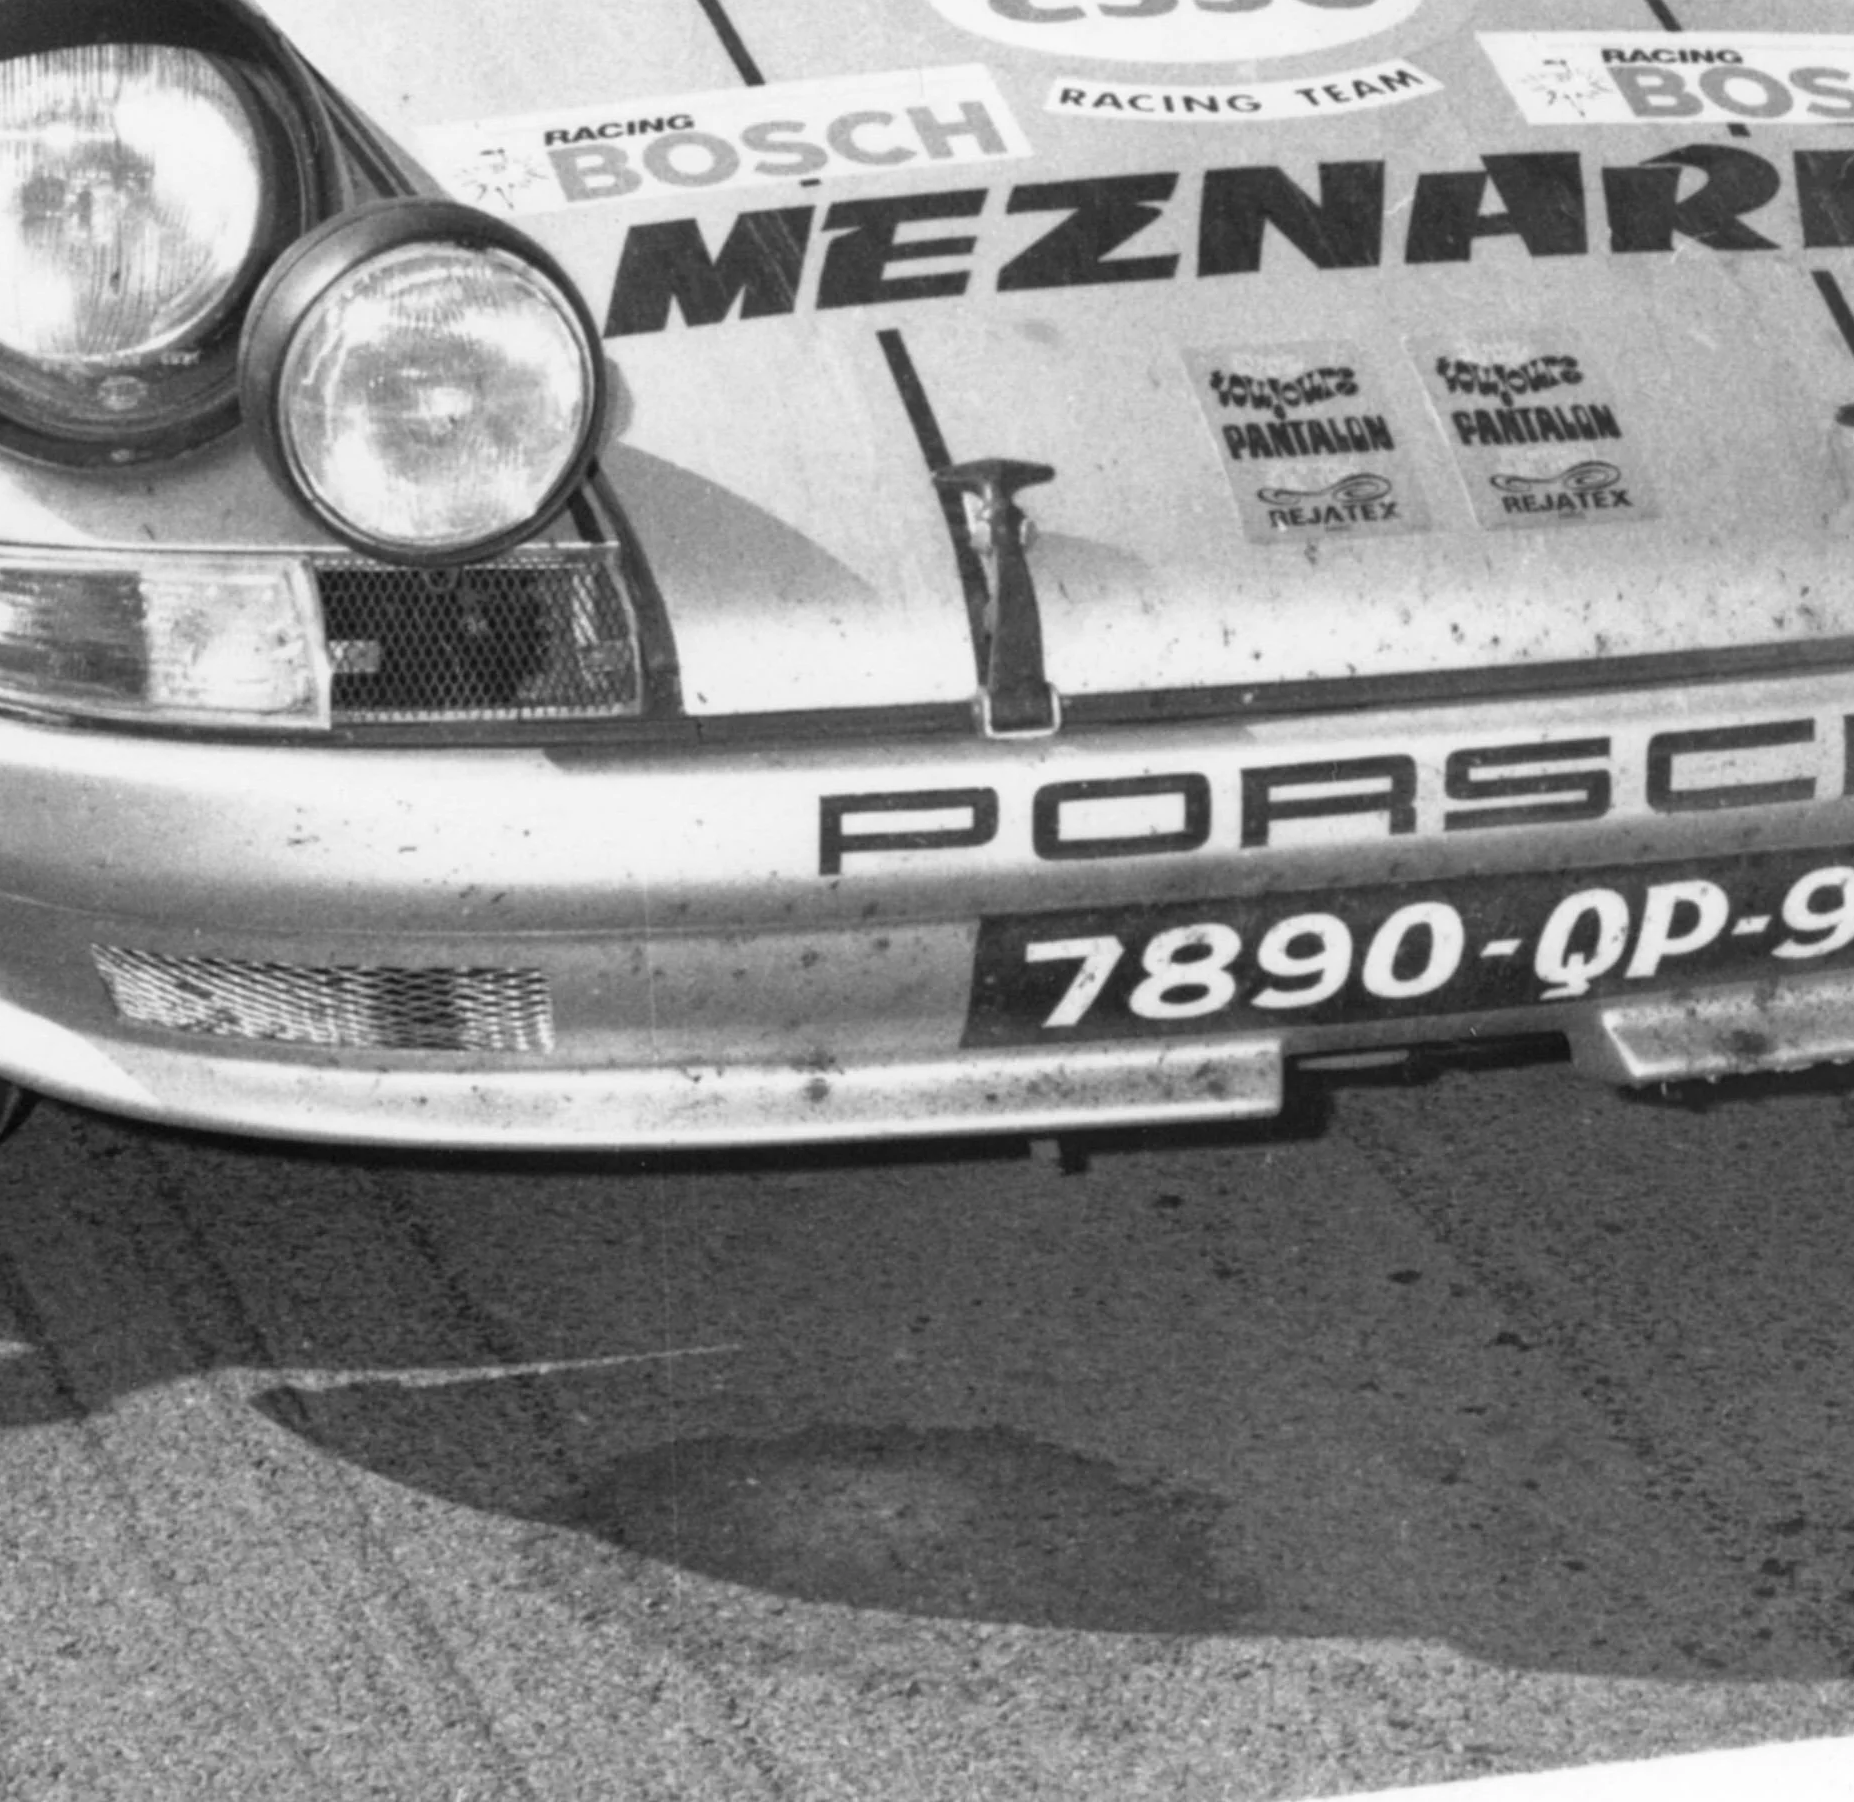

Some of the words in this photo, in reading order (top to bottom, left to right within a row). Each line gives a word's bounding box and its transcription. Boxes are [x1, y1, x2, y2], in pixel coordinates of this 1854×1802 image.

[1601, 48, 1744, 65] RACING
[1059, 86, 1262, 115] RACING
[1294, 68, 1424, 108] TEAM
[544, 111, 696, 147] RACING
[545, 99, 1008, 203] BOSCH
[1221, 415, 1395, 460] PANTALON
[1451, 403, 1622, 447] PANTALON
[1269, 501, 1402, 528] REJATEX
[1501, 488, 1634, 515] REJATEX
